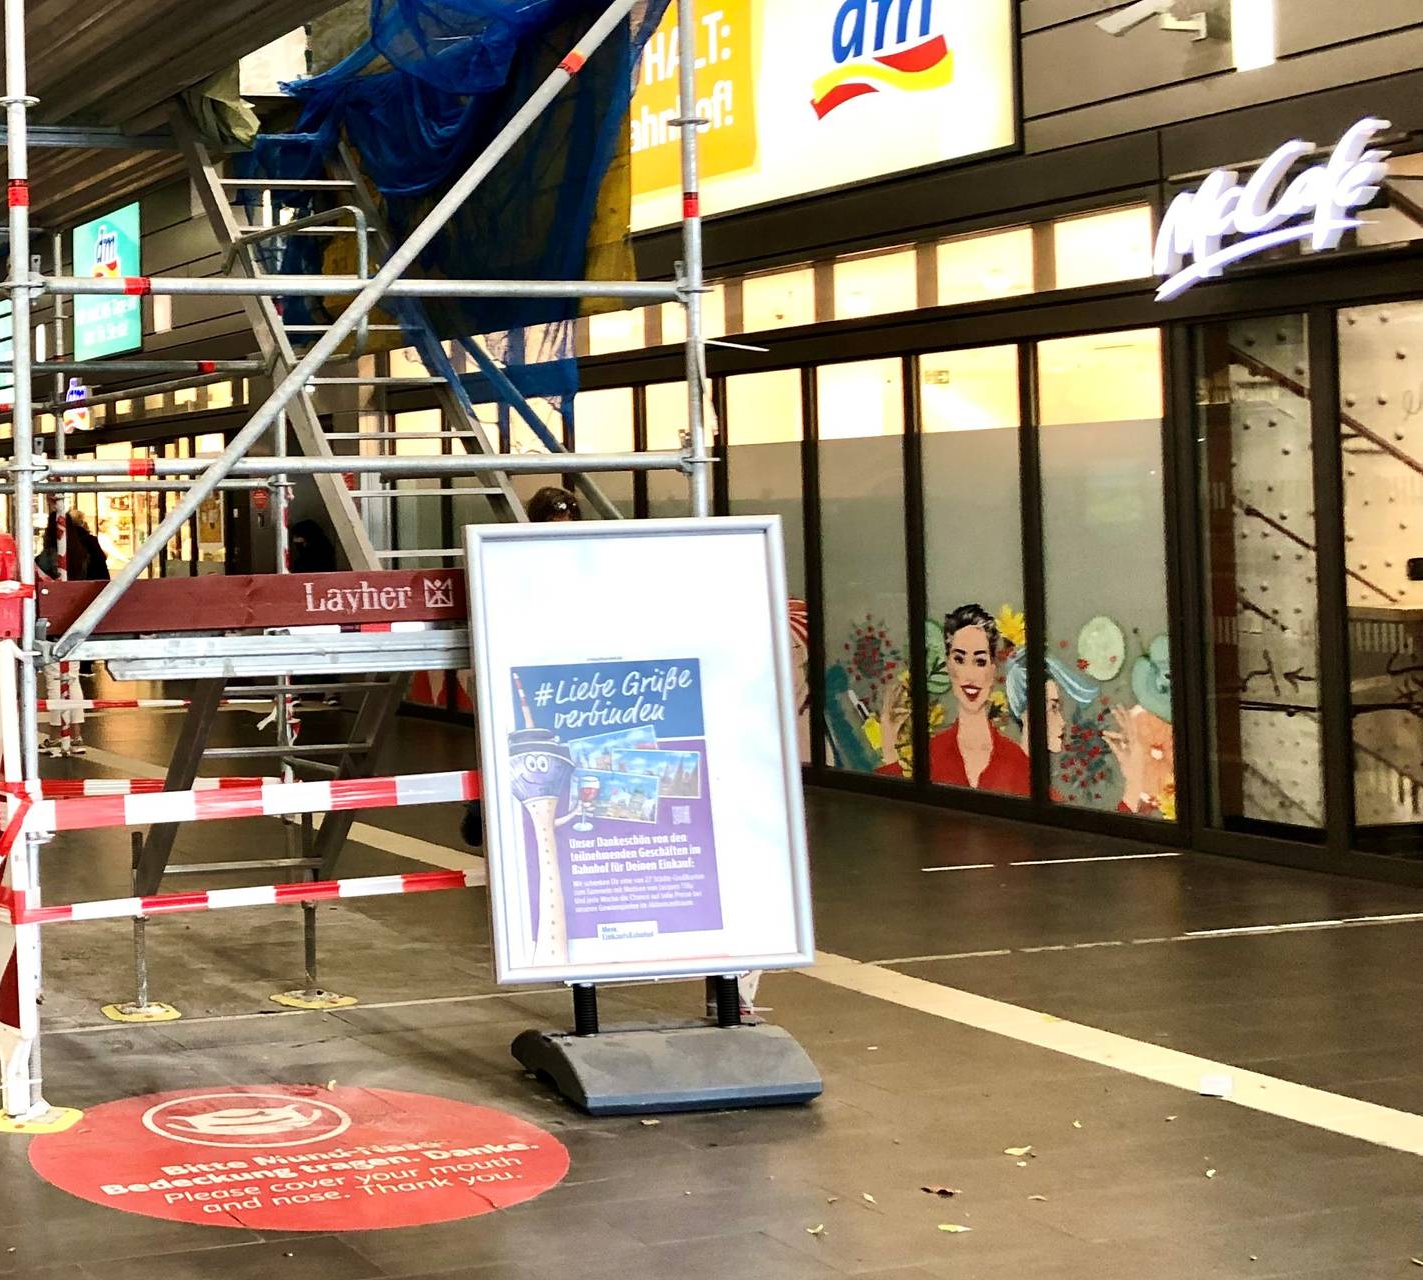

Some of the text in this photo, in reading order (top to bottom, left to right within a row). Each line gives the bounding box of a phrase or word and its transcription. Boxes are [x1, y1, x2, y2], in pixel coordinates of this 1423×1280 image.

[643, 10, 731, 86] HAT:
[303, 581, 412, 614] Layher
[534, 666, 692, 707] #Liebe Grüße
[554, 696, 665, 729] verbinden
[569, 832, 687, 848] Unser Dankeschön von den
[570, 844, 701, 861] teilnehmenden Geschäften im
[572, 863, 609, 875] Bahnhof
[610, 861, 624, 872] für
[625, 860, 657, 871] Deinen
[100, 1143, 540, 1196] Bedeckung tragen. Danke.
[161, 1160, 249, 1176] Bitte
[164, 1155, 524, 1205] Please cover your mouth
[202, 1169, 525, 1214] and nose. Thank you.
